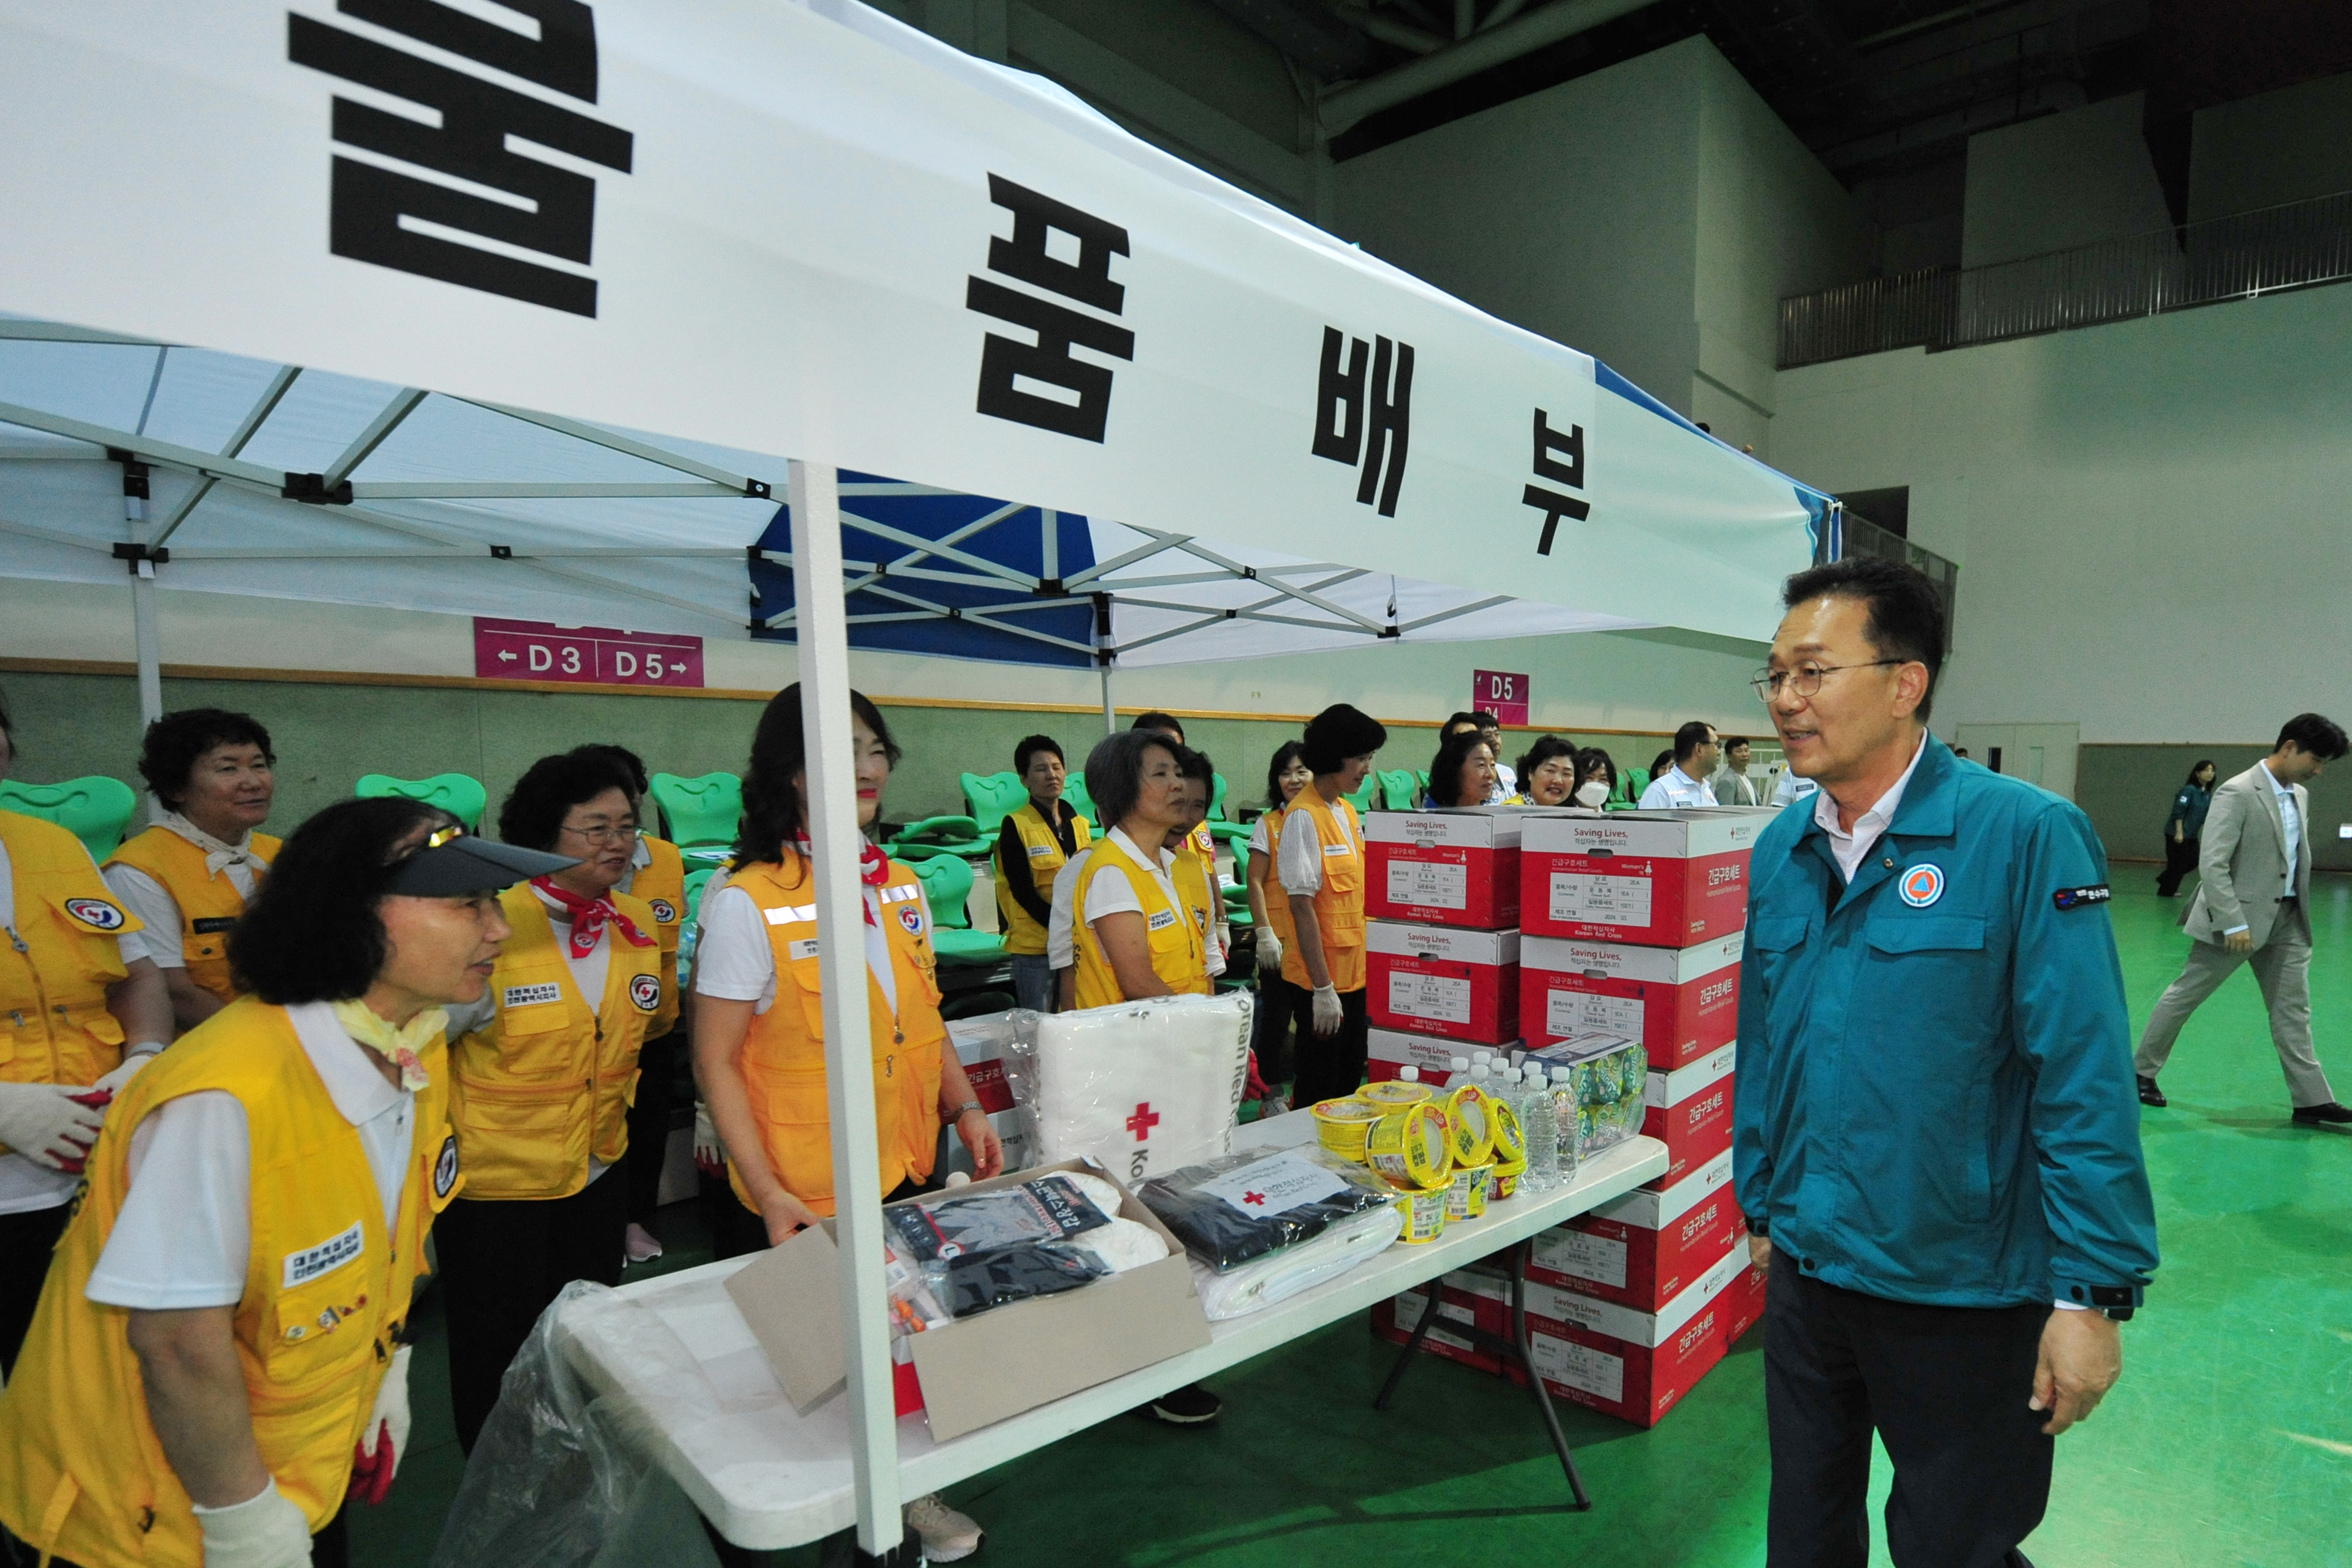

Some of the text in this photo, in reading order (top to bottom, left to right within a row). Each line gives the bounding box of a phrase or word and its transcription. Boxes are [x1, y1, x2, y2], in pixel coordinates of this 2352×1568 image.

[289, 0, 1590, 556] 물 품 배 부
[529, 644, 663, 678] D3 D5
[1492, 676, 1512, 700] D5
[1406, 820, 1448, 830] Saving Lives,
[1574, 828, 1628, 838] Saving Lives,
[1709, 864, 1740, 885] 긴급구호세트
[1408, 933, 1451, 944] Saving Lives,
[1390, 959, 1420, 967] 긴급구호세트
[1571, 948, 1621, 962] Saving Lives,
[1571, 958, 1591, 966] 적십자는
[1549, 976, 1584, 986] 긴급구호세트
[1700, 978, 1733, 1006] 긴급구호세트
[1236, 999, 1251, 1059] orean
[1409, 1043, 1451, 1056] Saving Lives,
[967, 1068, 1002, 1084] 긴급구호
[1689, 1091, 1723, 1124] 긴급구호세트
[1682, 1203, 1717, 1241] 긴급구호세트
[944, 1247, 956, 1255] L
[1554, 1296, 1602, 1317] Saving Lives,
[1679, 1311, 1714, 1353] 긴급구호세트
